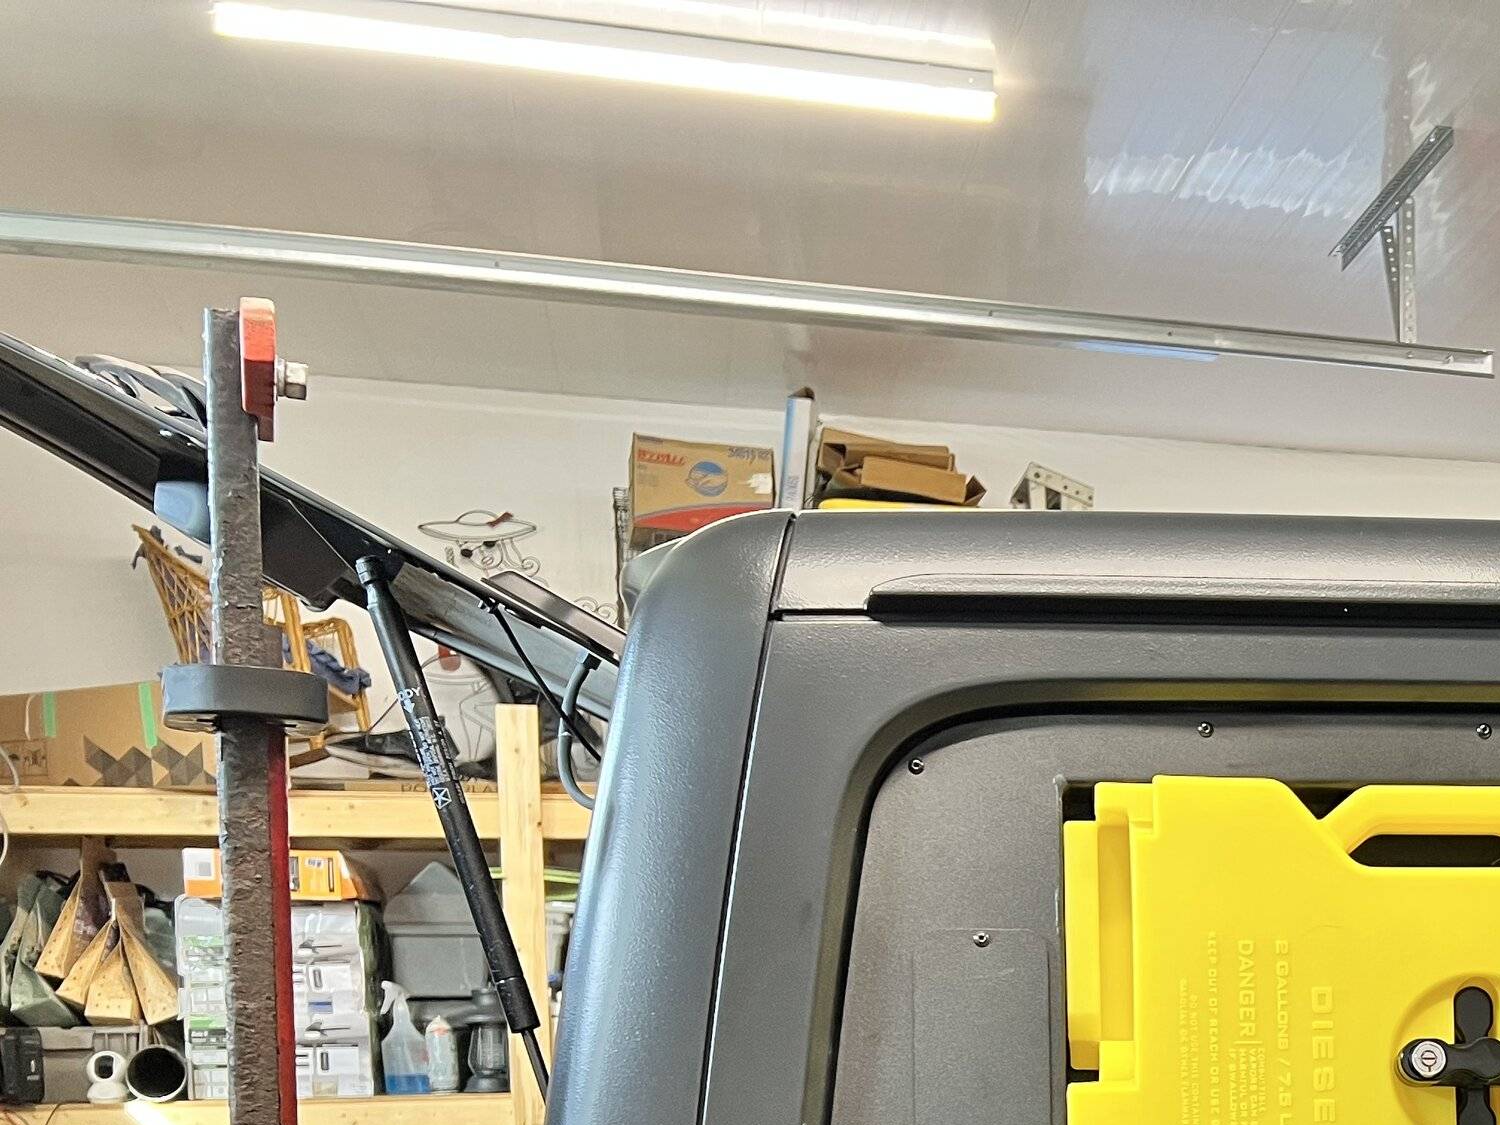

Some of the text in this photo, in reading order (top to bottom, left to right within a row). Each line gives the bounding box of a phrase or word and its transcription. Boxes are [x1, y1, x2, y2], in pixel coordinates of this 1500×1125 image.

[1275, 939, 1289, 955] 2
[1208, 968, 1218, 993] OUT
[1237, 939, 1256, 1038] DANGER
[1208, 997, 1218, 1015] OF
[1275, 960, 1290, 1050] GALLONS
[1209, 1066, 1219, 1084] OR
